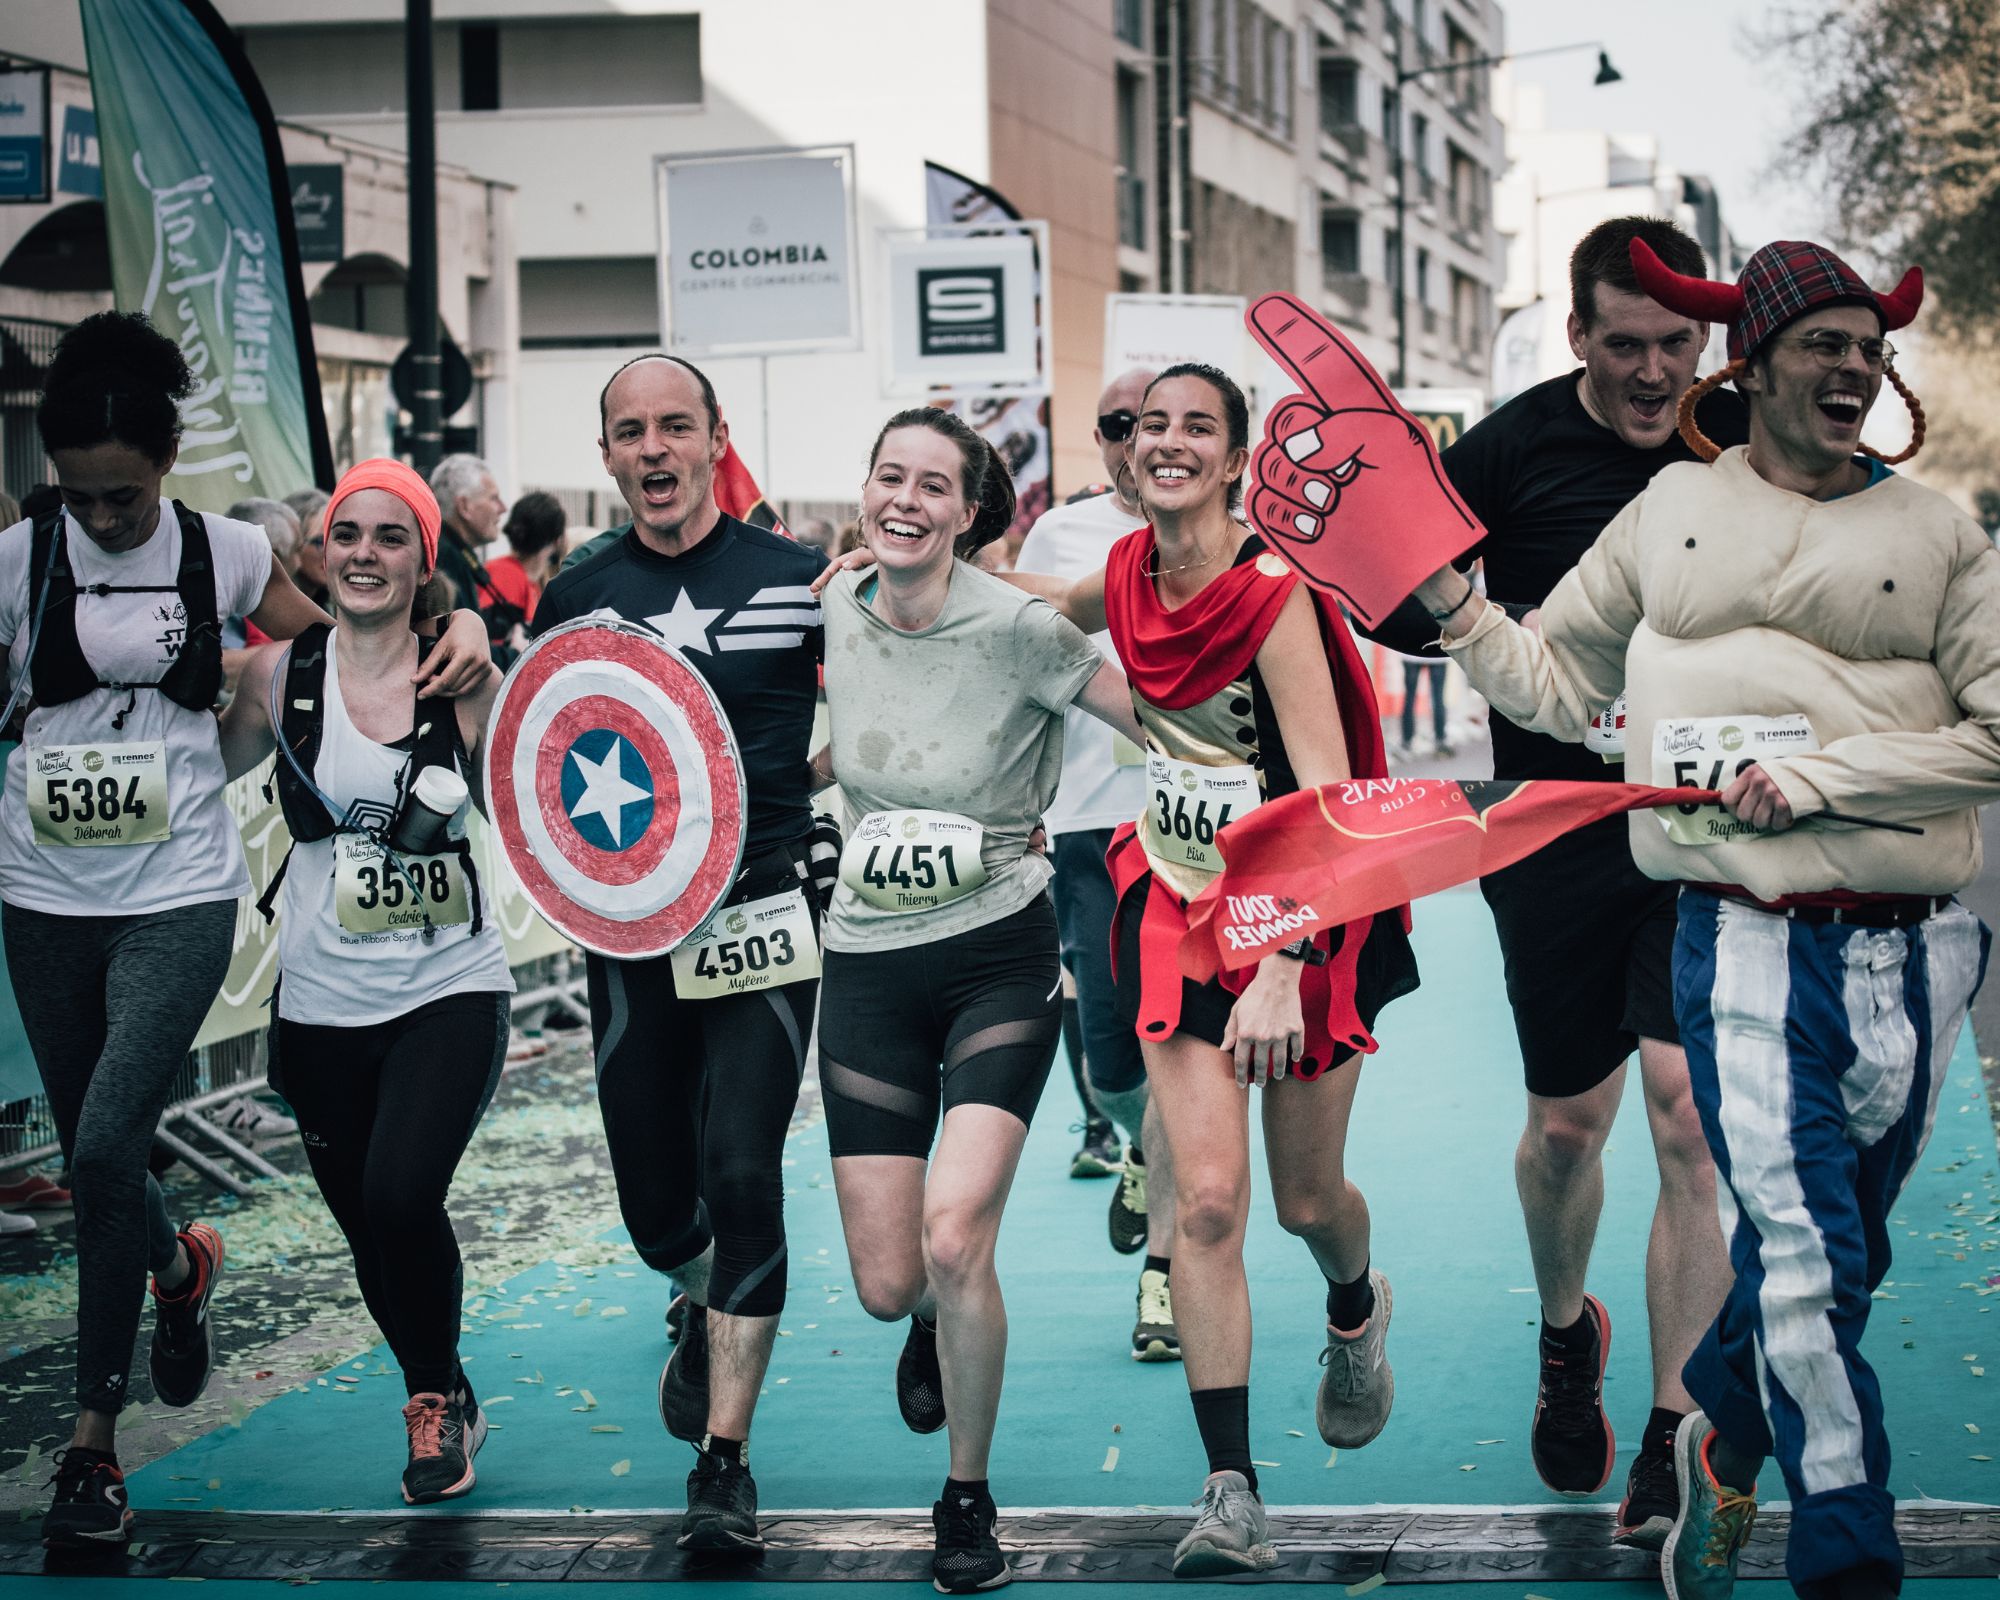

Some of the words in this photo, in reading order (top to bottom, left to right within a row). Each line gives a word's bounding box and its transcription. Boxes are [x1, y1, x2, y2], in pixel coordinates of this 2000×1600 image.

[690, 245, 828, 270] COLOMBIA
[680, 277, 737, 293] CENTRE
[742, 272, 840, 289] COMMERCIAL
[156, 628, 185, 643] ST
[1768, 728, 1808, 737] rennes
[122, 753, 155, 761] rennes
[1213, 779, 1247, 789] rennes
[1674, 757, 1760, 815] 54
[47, 776, 147, 823] 5384
[74, 825, 122, 840] Déborah
[938, 822, 972, 831] rennes
[1186, 846, 1206, 862] Lisa
[863, 845, 959, 889] 4451
[357, 860, 450, 909] 3598
[896, 893, 940, 907] Thierry
[388, 909, 422, 925] Cedric
[765, 903, 797, 918] rennes
[340, 936, 359, 944] Blue
[361, 935, 390, 944] Ribbon
[694, 928, 796, 980] 4503
[728, 974, 771, 992] Mylène
